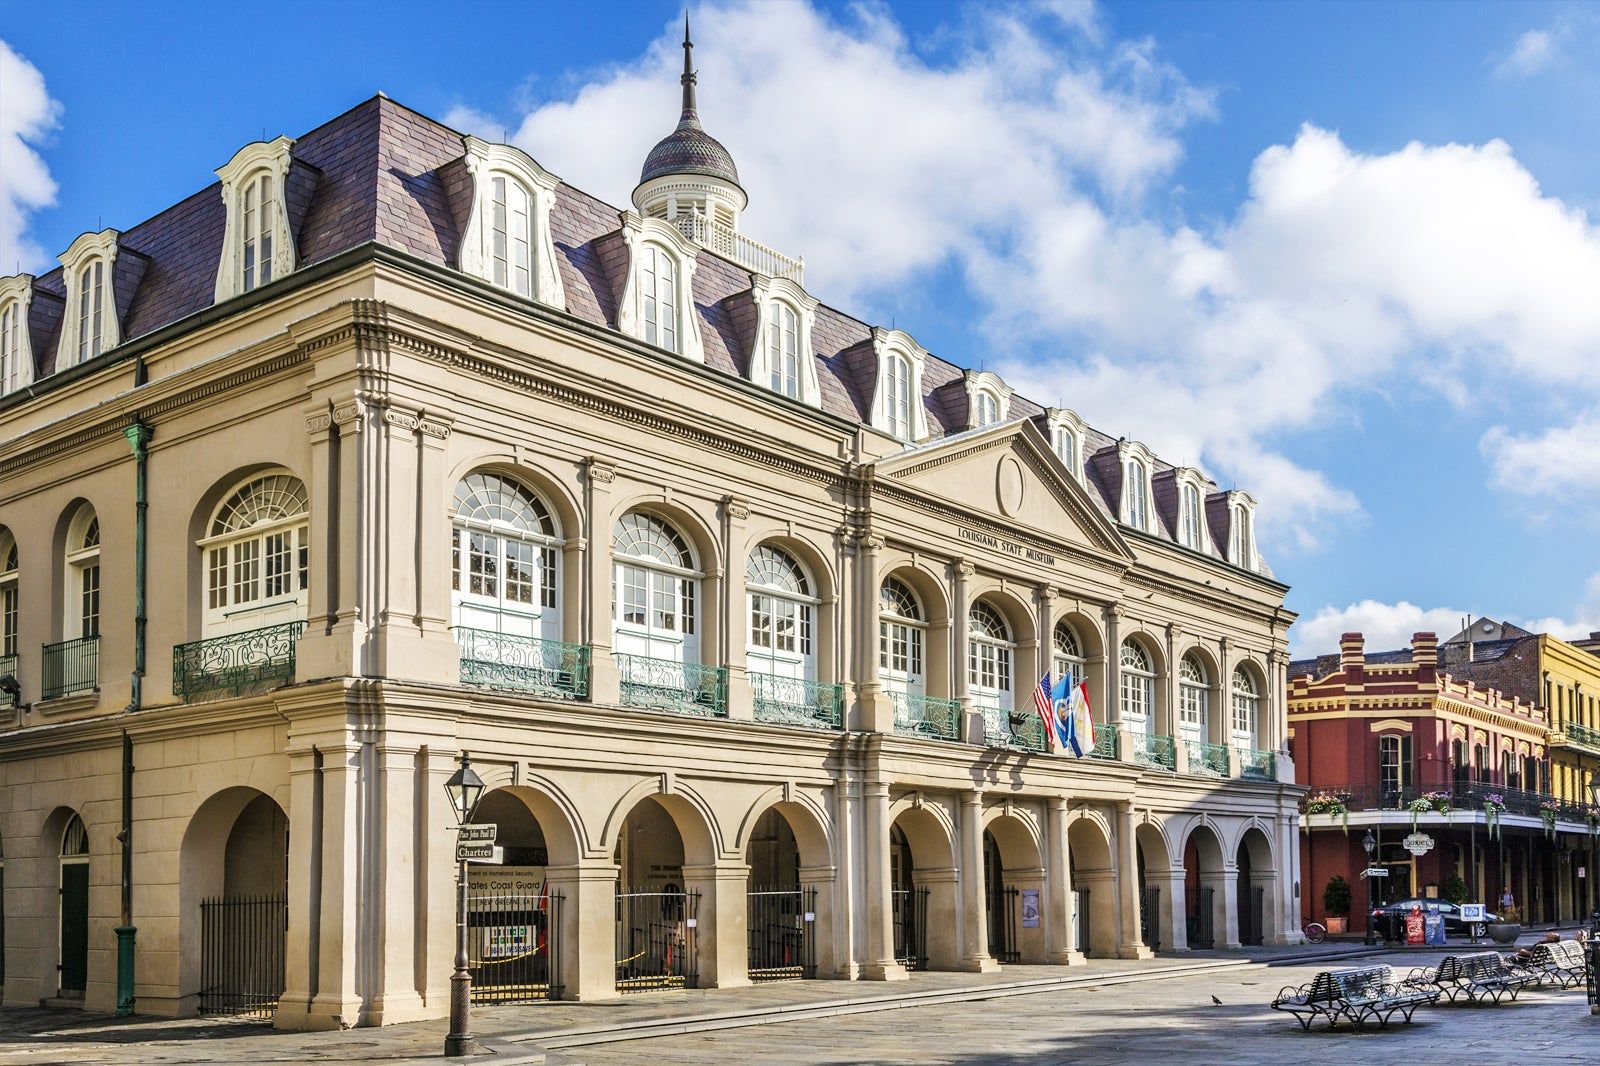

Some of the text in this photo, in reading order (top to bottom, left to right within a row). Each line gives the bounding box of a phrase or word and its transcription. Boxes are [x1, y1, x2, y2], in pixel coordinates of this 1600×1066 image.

[958, 528, 1055, 566] LOUISIANA STATE MUSEUM
[469, 829, 479, 840] John
[479, 829, 489, 838] Paul
[458, 847, 492, 857] Chartres
[490, 881, 513, 890] Coast
[515, 881, 540, 890] Guard
